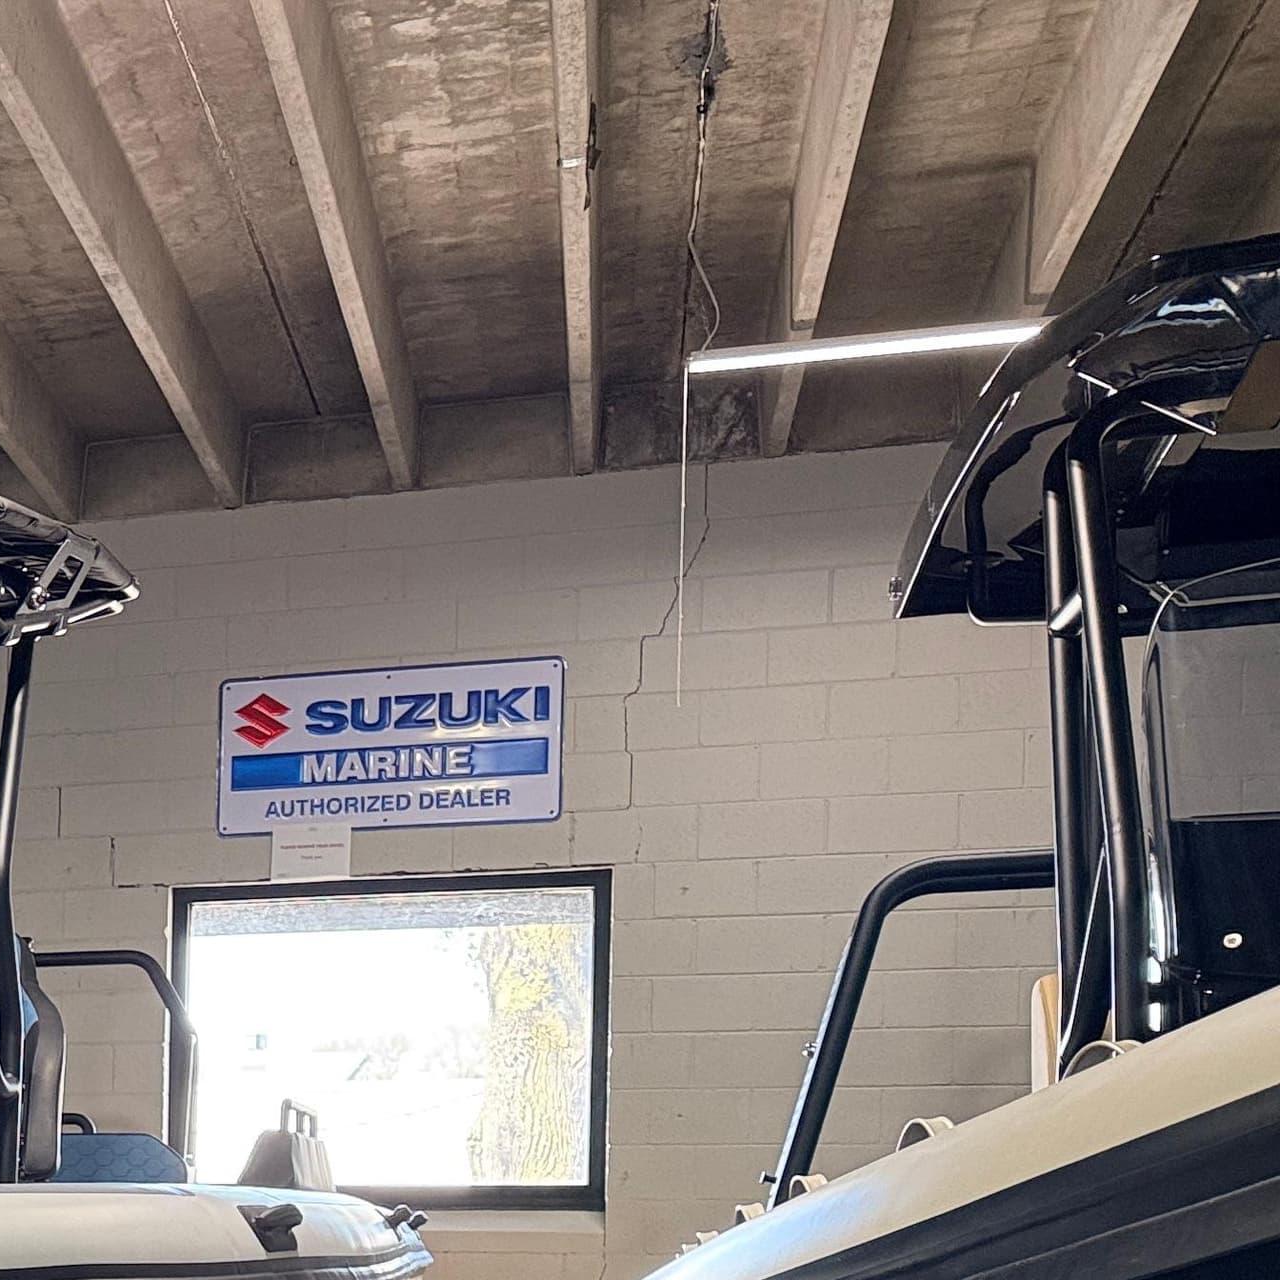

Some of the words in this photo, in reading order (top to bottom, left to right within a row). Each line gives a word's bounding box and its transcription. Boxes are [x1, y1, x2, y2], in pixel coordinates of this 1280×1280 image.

[304, 685, 551, 736] SUZUKI
[301, 743, 474, 784] MARINE
[264, 793, 412, 819] AUTHORIZED
[418, 787, 512, 812] DEALER
